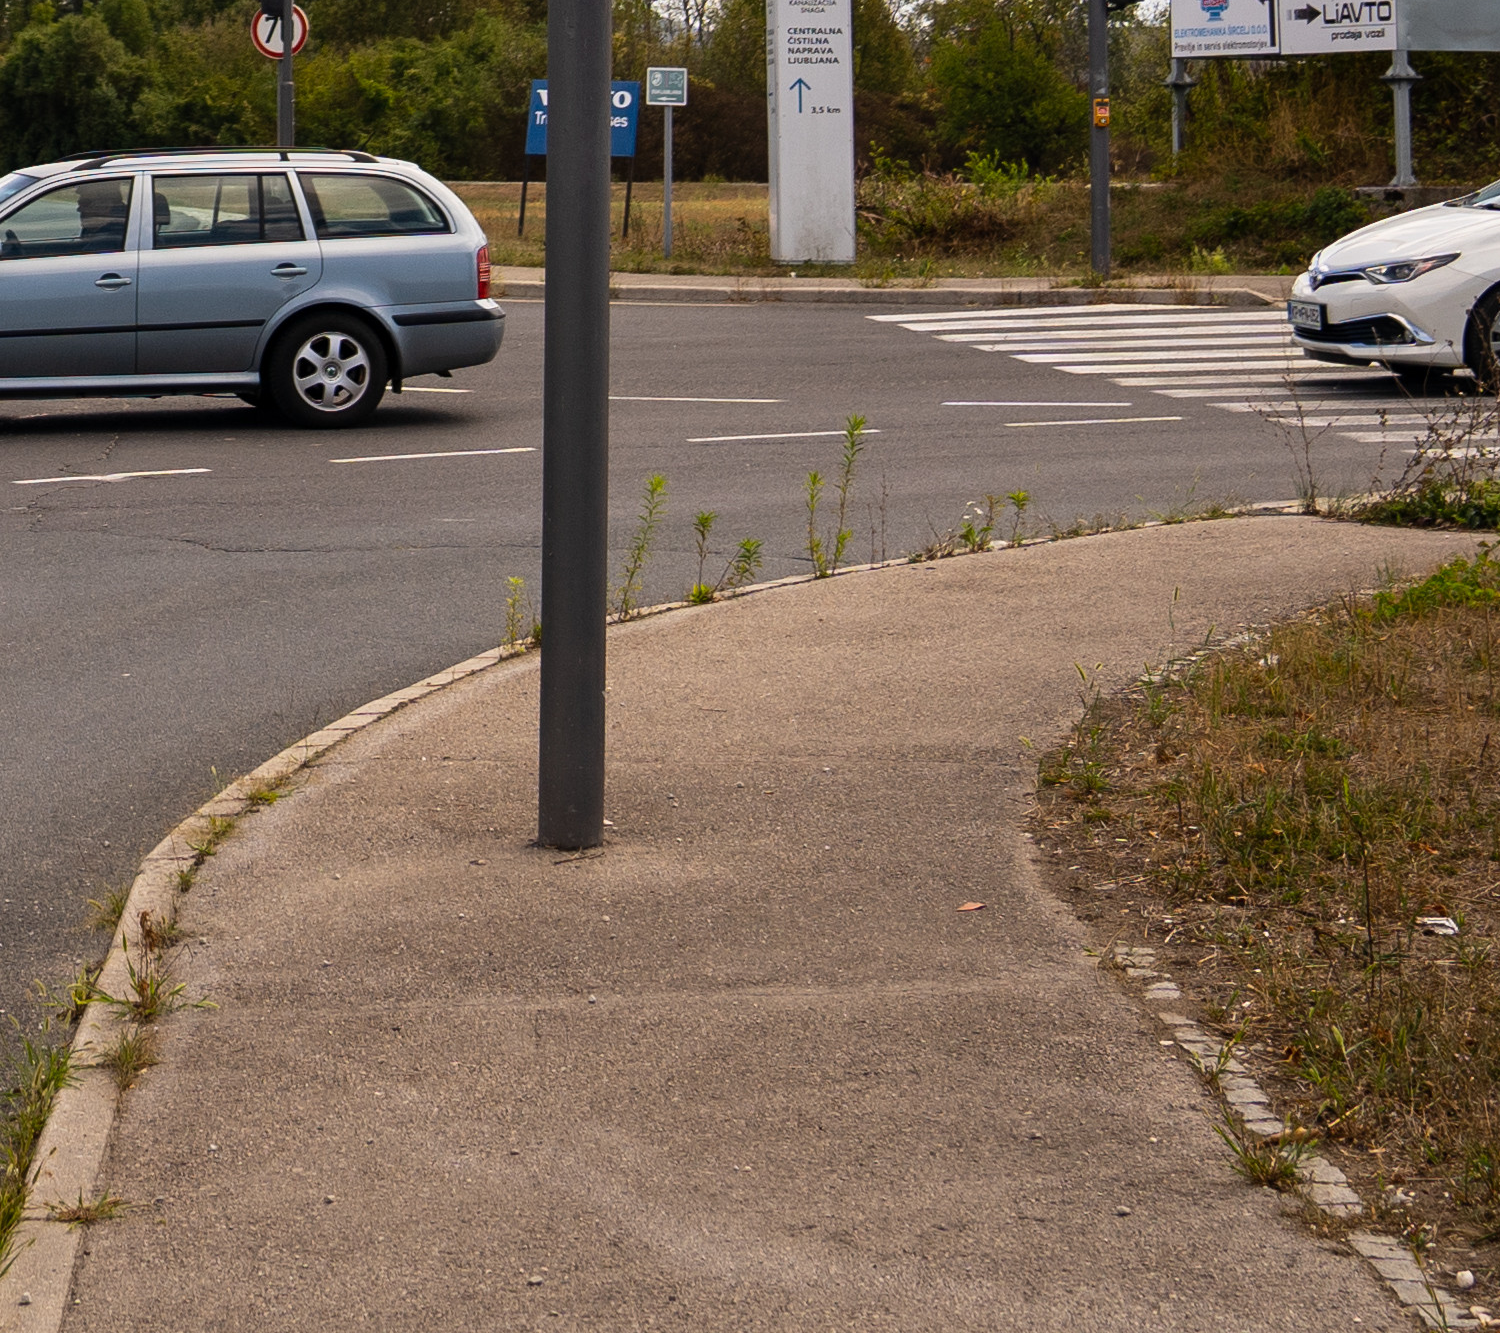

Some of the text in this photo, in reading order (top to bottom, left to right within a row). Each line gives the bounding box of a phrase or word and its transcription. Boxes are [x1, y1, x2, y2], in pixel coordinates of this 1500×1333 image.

[264, 16, 295, 44] 7
[787, 27, 843, 35] CENTRALNA
[1331, 27, 1386, 42] prodaja vozil
[787, 36, 830, 45] ČISTILNA
[787, 47, 834, 55] NAPRAVA
[787, 56, 840, 65] LJUBLJANA
[826, 106, 841, 114] km
